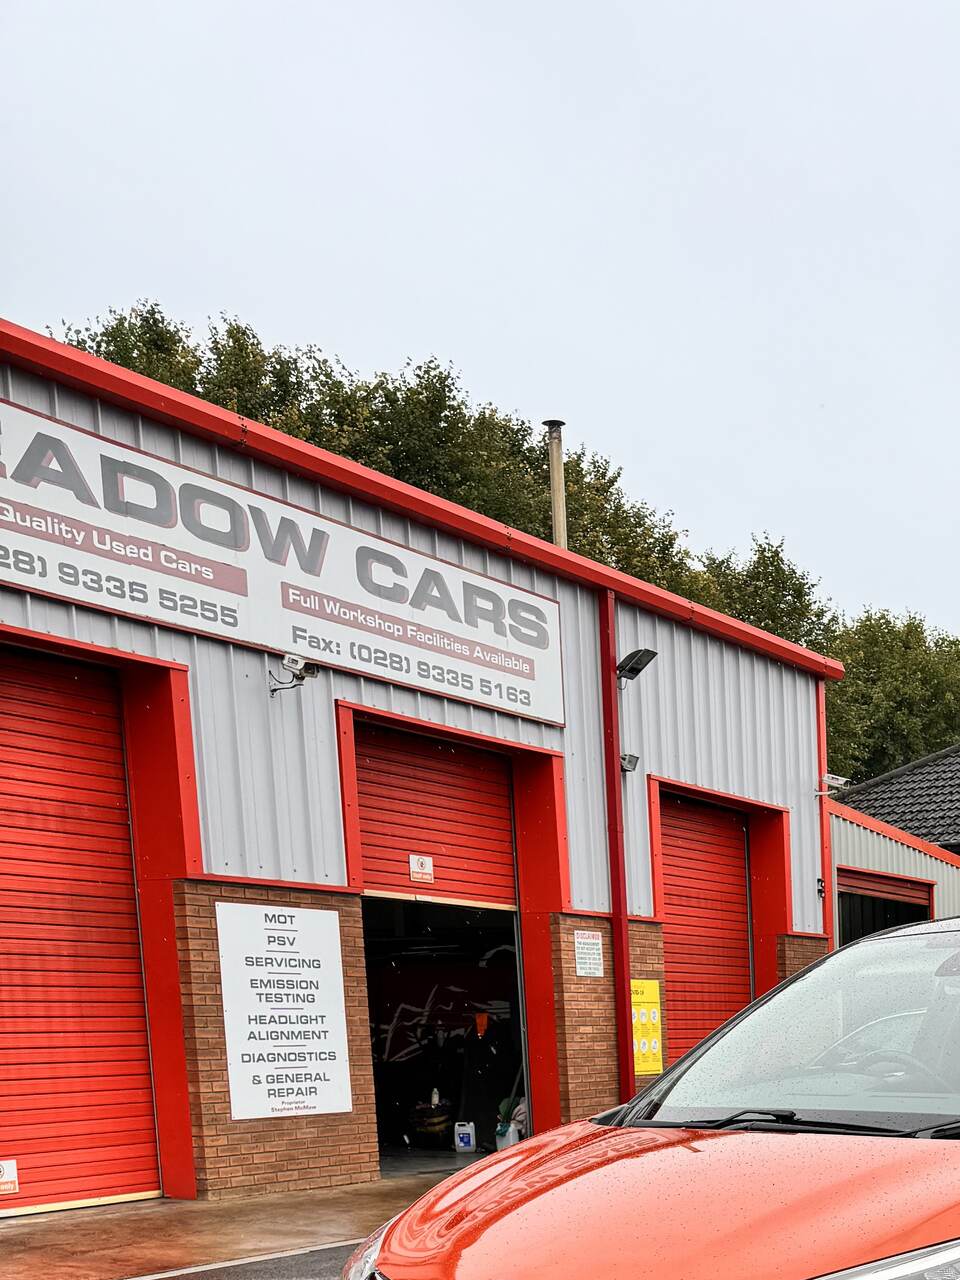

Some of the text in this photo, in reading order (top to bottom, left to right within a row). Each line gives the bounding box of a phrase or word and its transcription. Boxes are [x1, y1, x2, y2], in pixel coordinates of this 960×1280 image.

[0, 418, 549, 649] ADOW CARS
[0, 503, 214, 580] Quality Used Cars
[58, 561, 149, 604] 9335
[158, 587, 239, 628] 5255
[289, 588, 531, 673] Full Workshop Facilities Available
[292, 625, 532, 706] Fax: (028) 9335 5163
[264, 913, 296, 925] MOT
[267, 935, 296, 946] PSV
[245, 956, 321, 969] SERVICING
[250, 979, 319, 990] EMISSION
[256, 993, 315, 1003] TESTING
[248, 1015, 326, 1025] HEADLIGHT
[247, 1030, 329, 1041] ALIGNMENT
[241, 1051, 336, 1063] DIAGNOSTICS
[252, 1072, 331, 1085] & GENERAL
[267, 1086, 318, 1098] REPAIR
